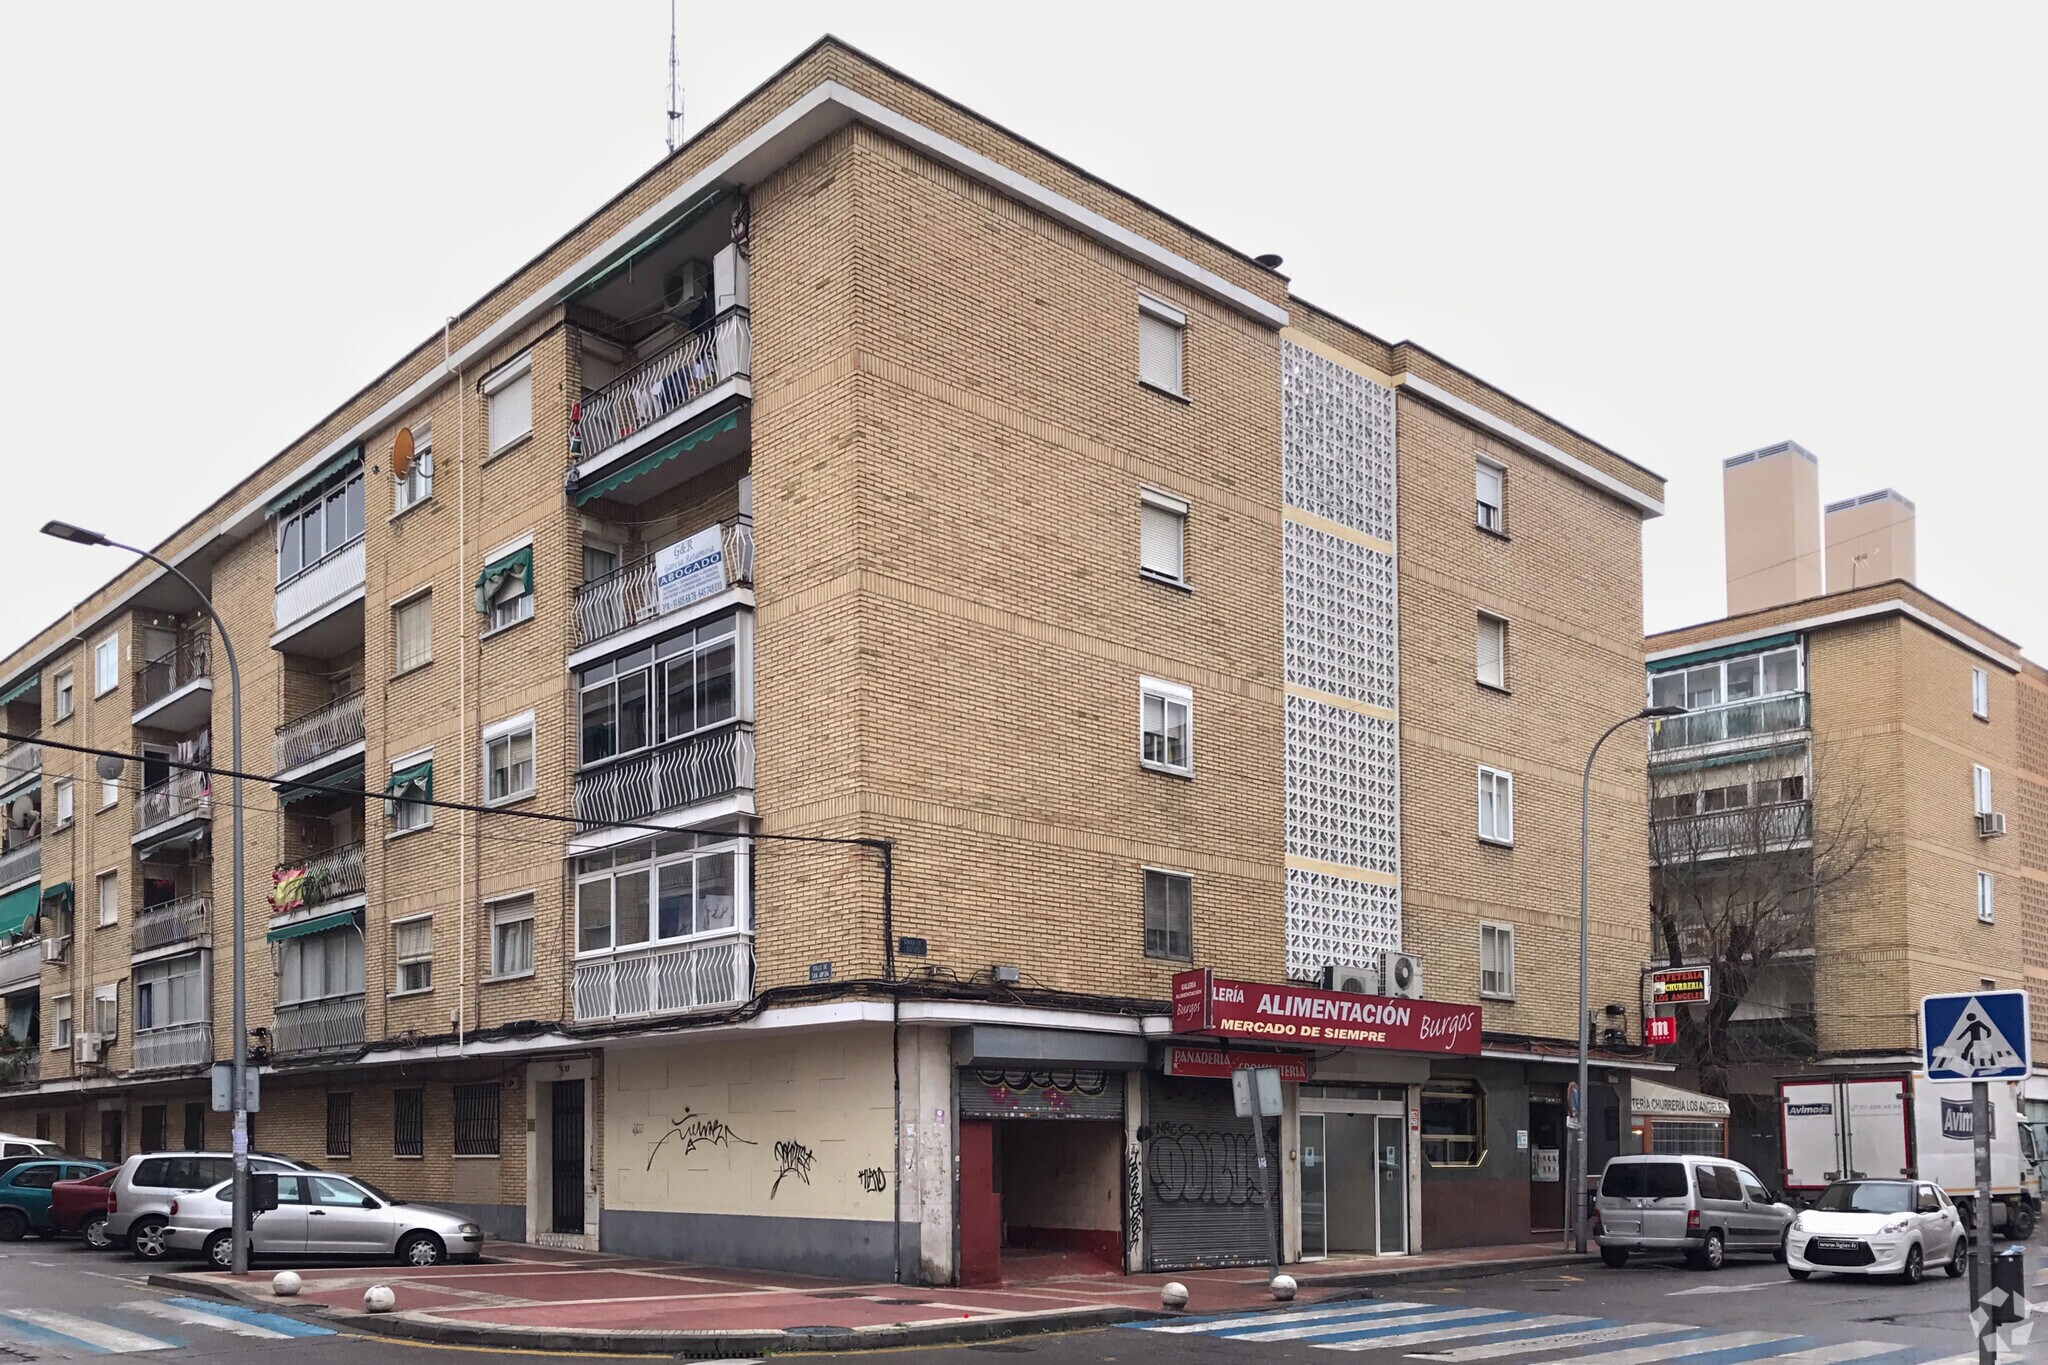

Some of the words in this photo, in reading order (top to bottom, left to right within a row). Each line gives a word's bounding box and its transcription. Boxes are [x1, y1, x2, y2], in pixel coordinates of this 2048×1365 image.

[674, 539, 693, 559] G&R
[660, 553, 720, 586] ABOGADO
[1655, 972, 1703, 982] CAFETERIA
[1665, 982, 1703, 991] CHURRERIA
[1672, 992, 1703, 1000] ANGELES
[1212, 985, 1245, 1003] LERÍA
[1257, 993, 1411, 1026] ALIMENTACIÓN
[1419, 1011, 1475, 1050] Burgos
[1220, 1019, 1296, 1035] MERCADO
[1300, 1026, 1321, 1037] DE
[1324, 1027, 1386, 1043] SIEMPRE
[1174, 1050, 1231, 1066] PANADERIA
[1632, 1096, 1650, 1110] TERÍA
[1687, 1100, 1698, 1111] LOS
[1789, 1105, 1830, 1115] Avimosa
